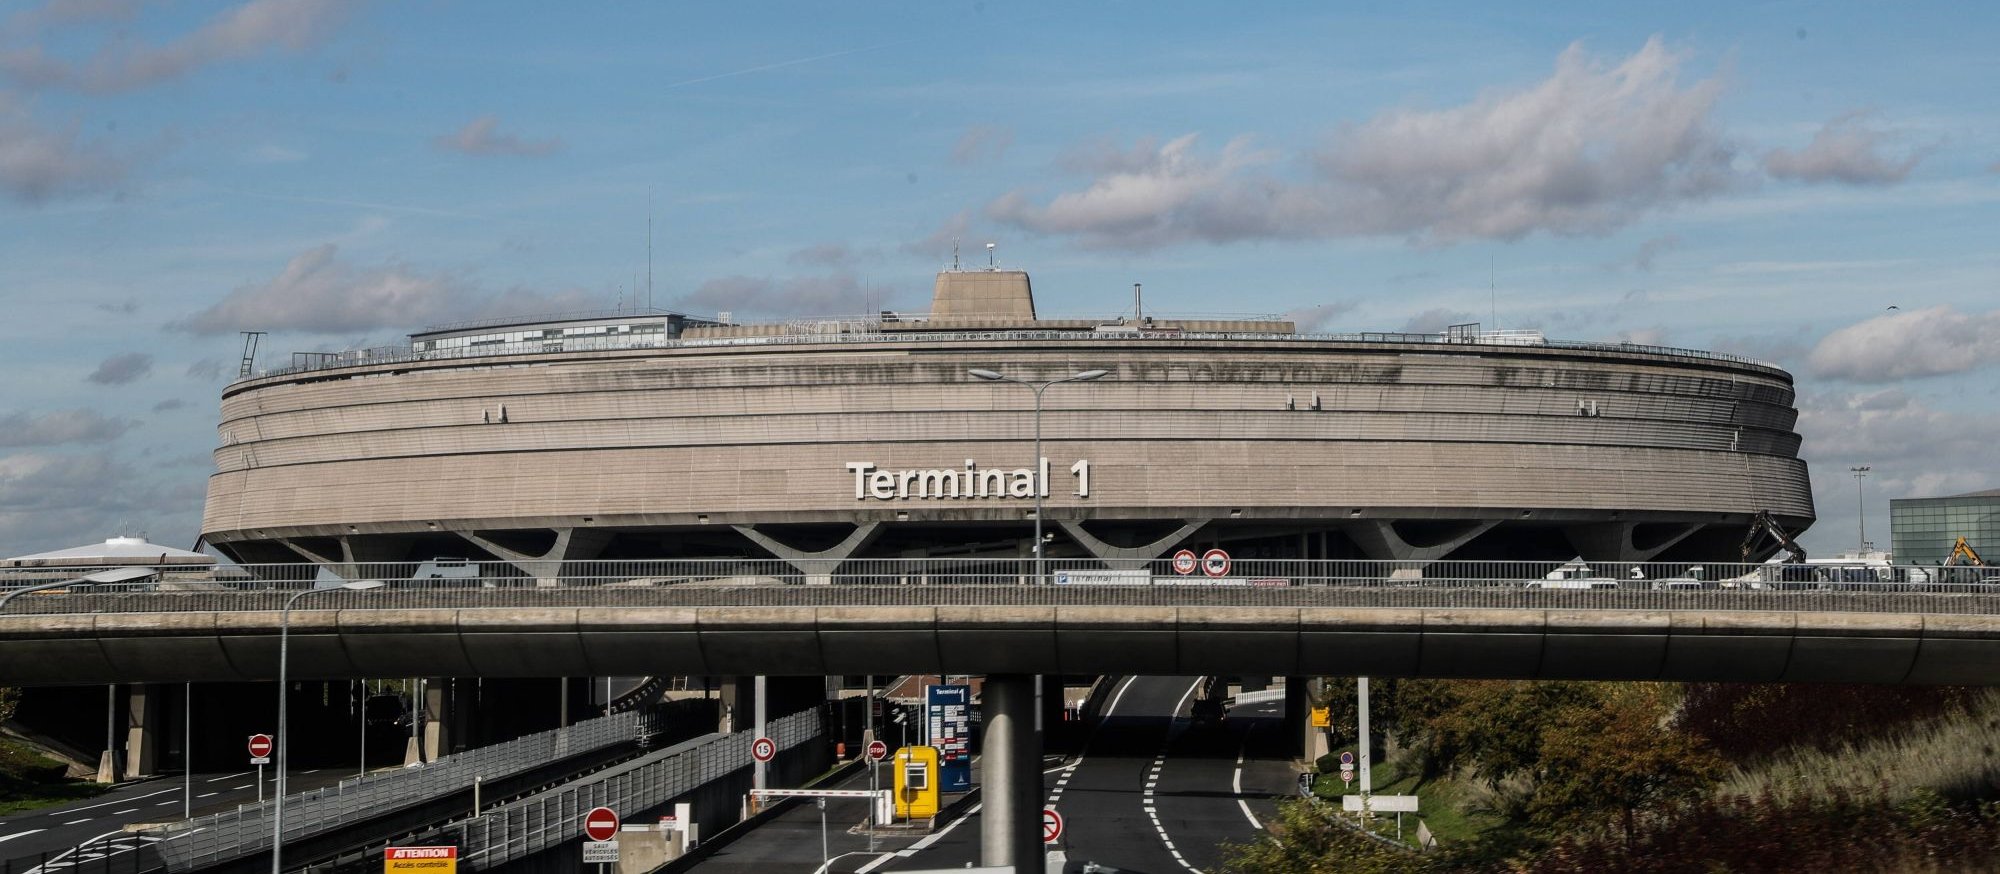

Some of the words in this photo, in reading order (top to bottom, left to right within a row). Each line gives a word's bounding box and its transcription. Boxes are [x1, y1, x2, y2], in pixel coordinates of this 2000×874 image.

[846, 457, 1049, 500] Terminal
[1070, 459, 1090, 498] 1
[959, 688, 965, 702] 1
[758, 744, 769, 755] 15
[393, 848, 449, 859] ATTENTION
[393, 861, 415, 869] Accès
